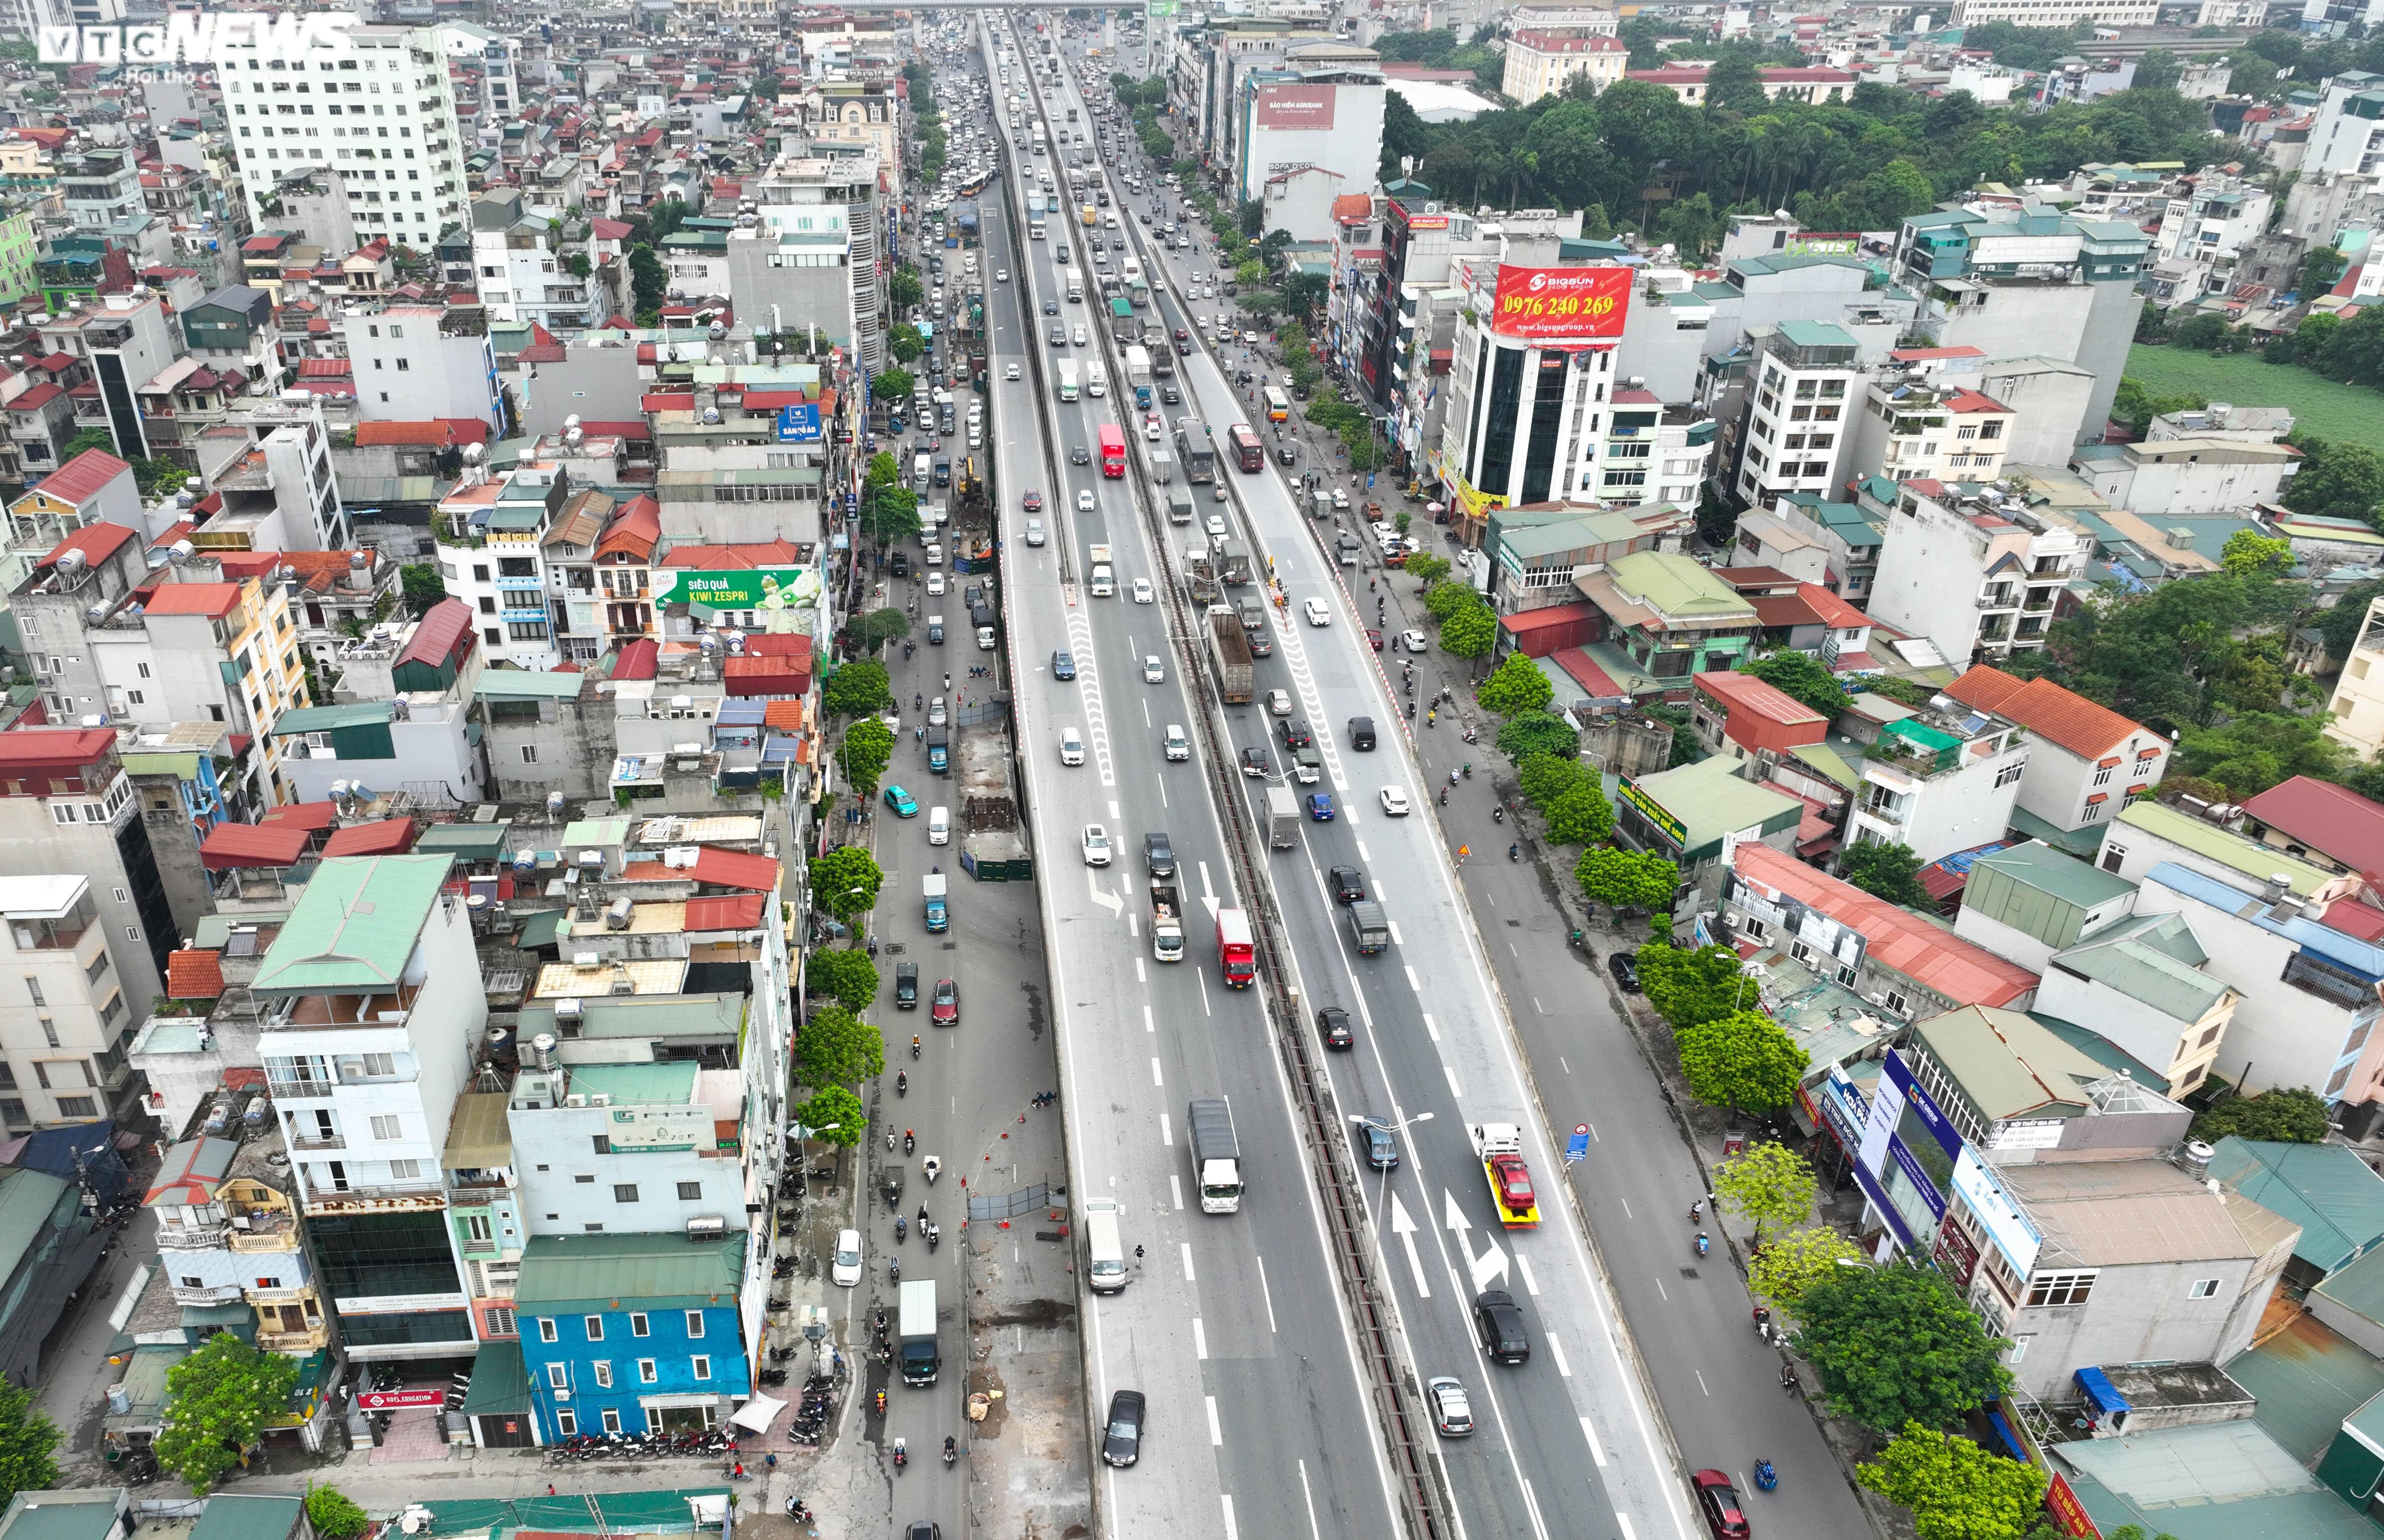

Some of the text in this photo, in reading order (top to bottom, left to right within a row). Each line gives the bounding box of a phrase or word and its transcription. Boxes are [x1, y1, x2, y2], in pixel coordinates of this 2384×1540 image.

[1785, 240, 1857, 257] FASTER
[1504, 295, 1613, 315] 0976 240 269
[1516, 324, 1594, 332] www.bigsungroup.vn
[783, 426, 797, 435] SÀN
[486, 533, 498, 542] ANH
[512, 533, 531, 542] OCEAN
[688, 577, 729, 591] SIÊU QUẢ
[688, 591, 748, 602] KIWI ZESPRI
[1636, 796, 1647, 811] SẢN
[1647, 806, 1660, 822] XUẤT
[1671, 827, 1685, 843] SOFA
[1843, 1088, 1856, 1114] HOA
[1878, 1086, 1897, 1114] WORKSPACE
[1877, 1102, 1891, 1123] TRAINING
[1924, 1104, 1938, 1123] GROUP
[1874, 1115, 1886, 1133] EVENTS
[2062, 1497, 2076, 1517] BẾP
